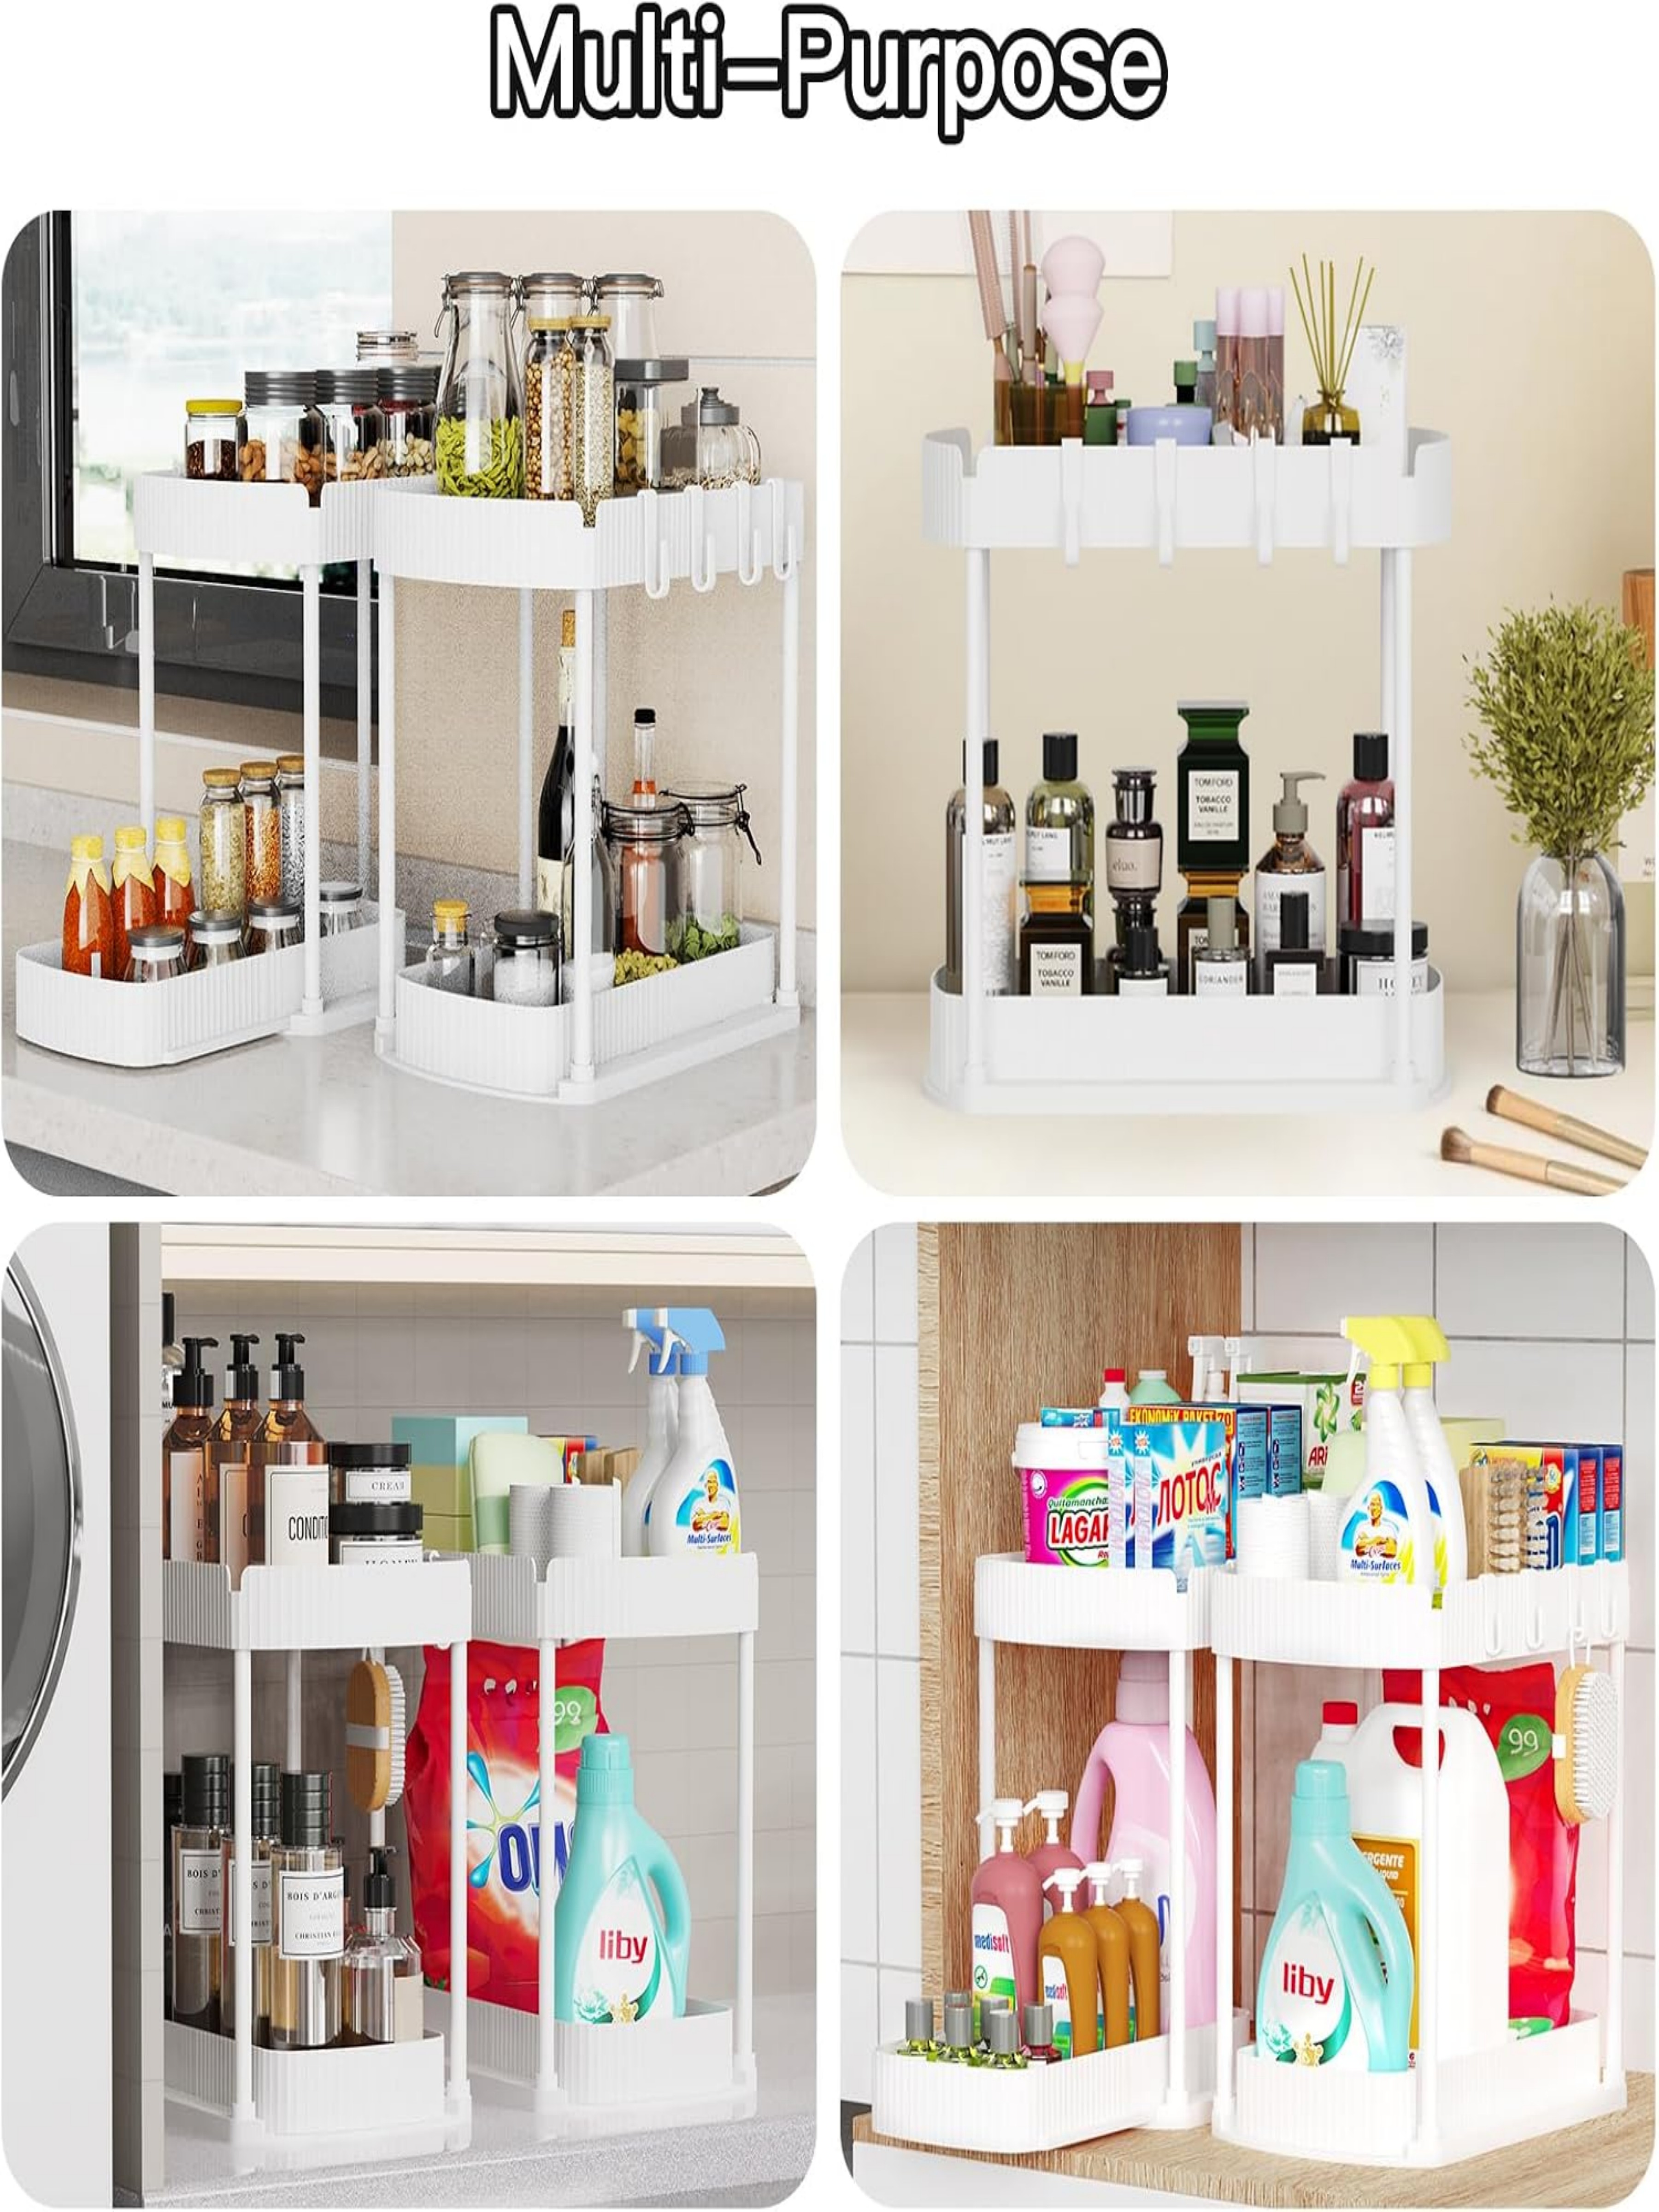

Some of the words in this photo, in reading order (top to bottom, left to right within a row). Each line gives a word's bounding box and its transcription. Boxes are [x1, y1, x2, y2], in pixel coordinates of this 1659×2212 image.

[1196, 795, 1231, 804] TOBACCO
[1038, 969, 1074, 978] TOBACCO
[1351, 1559, 1401, 1571] Multi-Surfaces
[1508, 1728, 1538, 1757] 99
[188, 1870, 208, 1878] BOIS
[287, 1892, 309, 1901] BOIS
[600, 1930, 647, 1964] liby
[1283, 1962, 1335, 2005] liby
